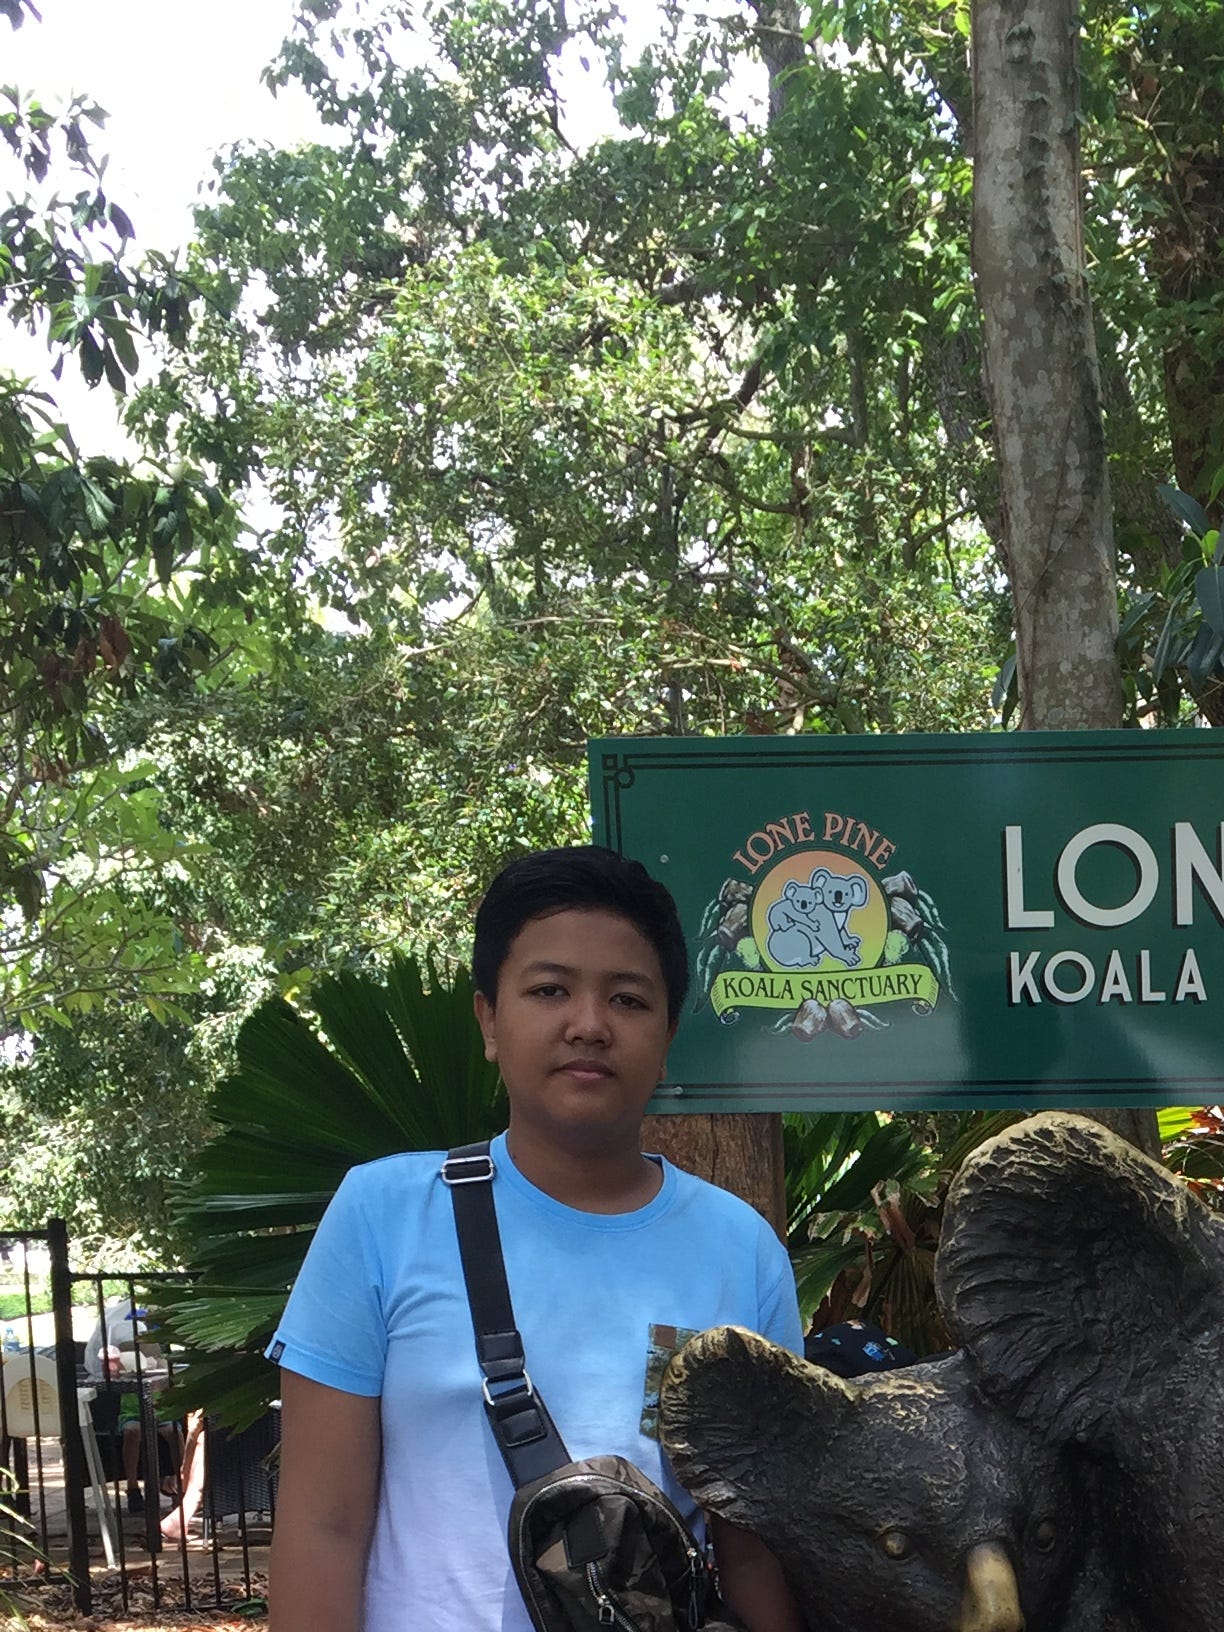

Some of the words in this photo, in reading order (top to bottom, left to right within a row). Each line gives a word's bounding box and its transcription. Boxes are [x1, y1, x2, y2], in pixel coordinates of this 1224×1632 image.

[733, 811, 815, 874] LONE
[822, 812, 897, 870] PINE
[722, 975, 794, 1001] KOALA
[800, 972, 923, 1001] SANCTUARY
[1009, 950, 1209, 1004] KOALA
